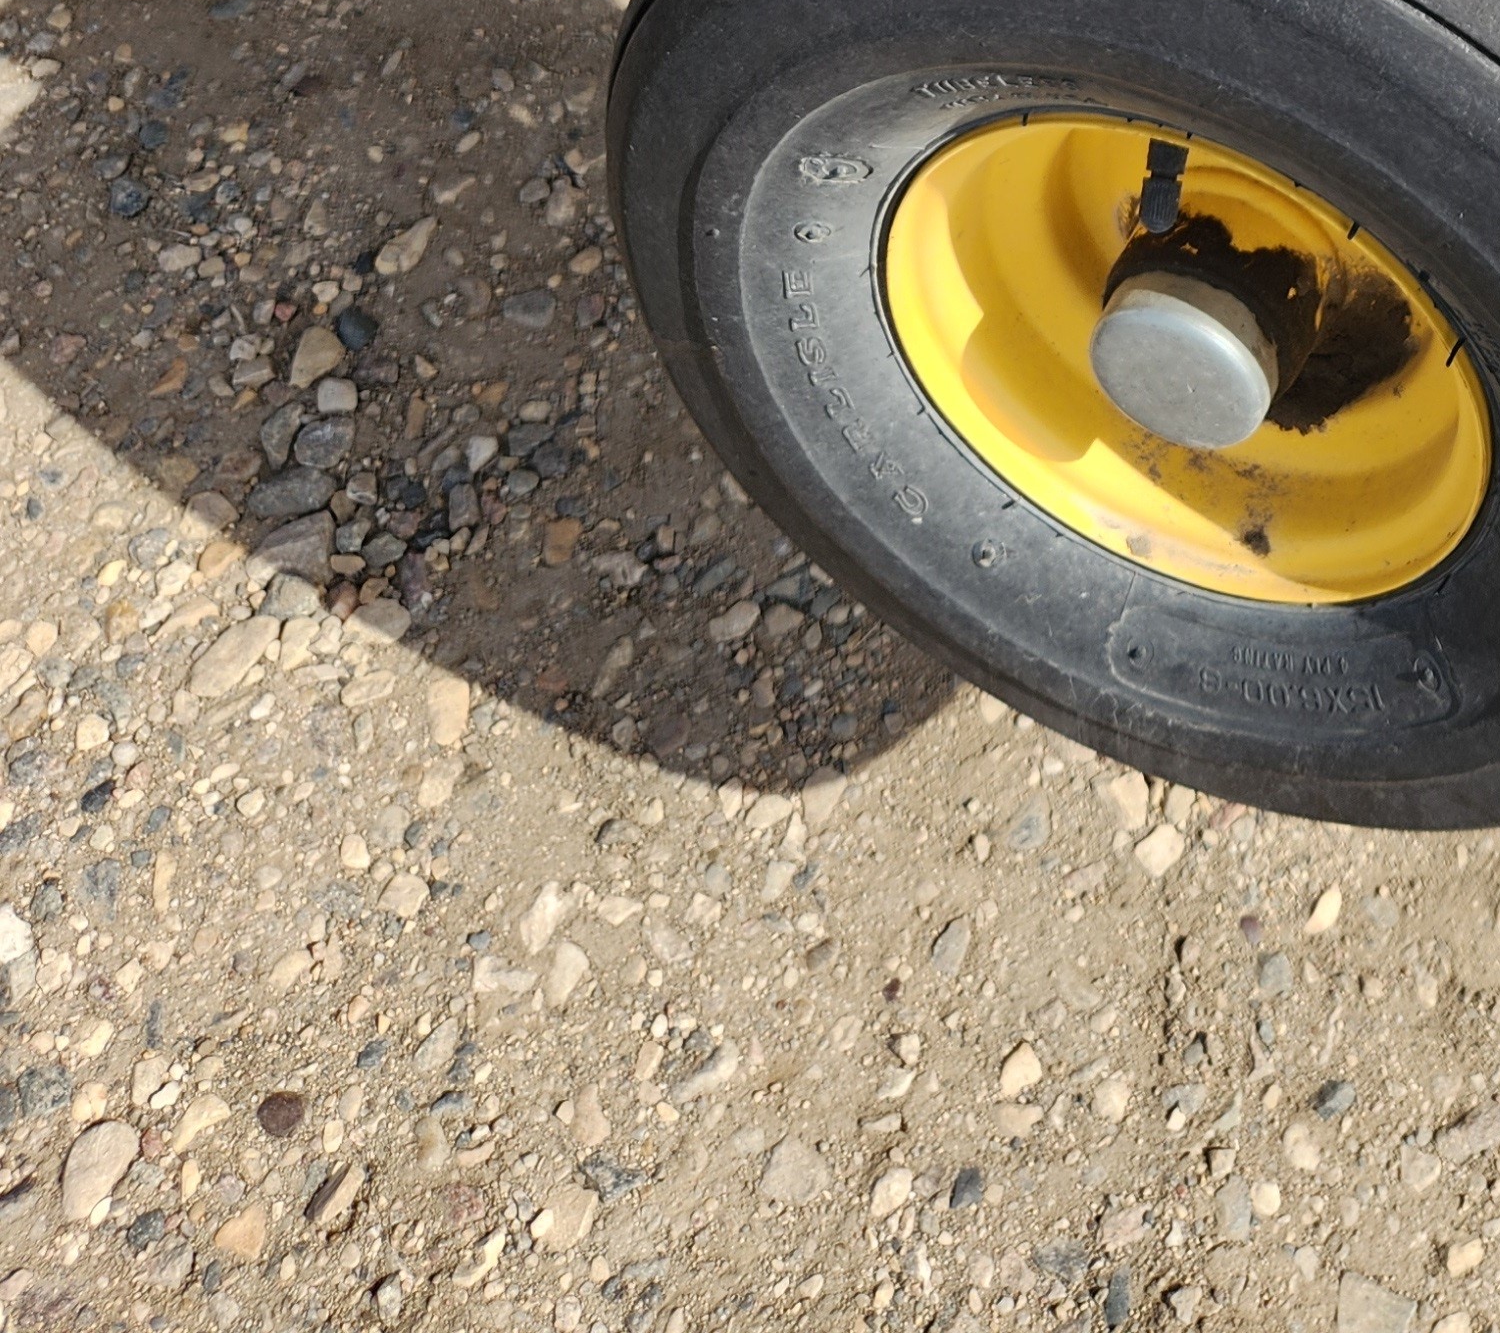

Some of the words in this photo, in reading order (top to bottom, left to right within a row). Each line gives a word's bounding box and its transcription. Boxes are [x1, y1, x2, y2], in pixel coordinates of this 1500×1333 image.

[782, 269, 930, 516] CARLISLE
[1232, 645, 1295, 673] RATING
[1303, 655, 1332, 675] PLY
